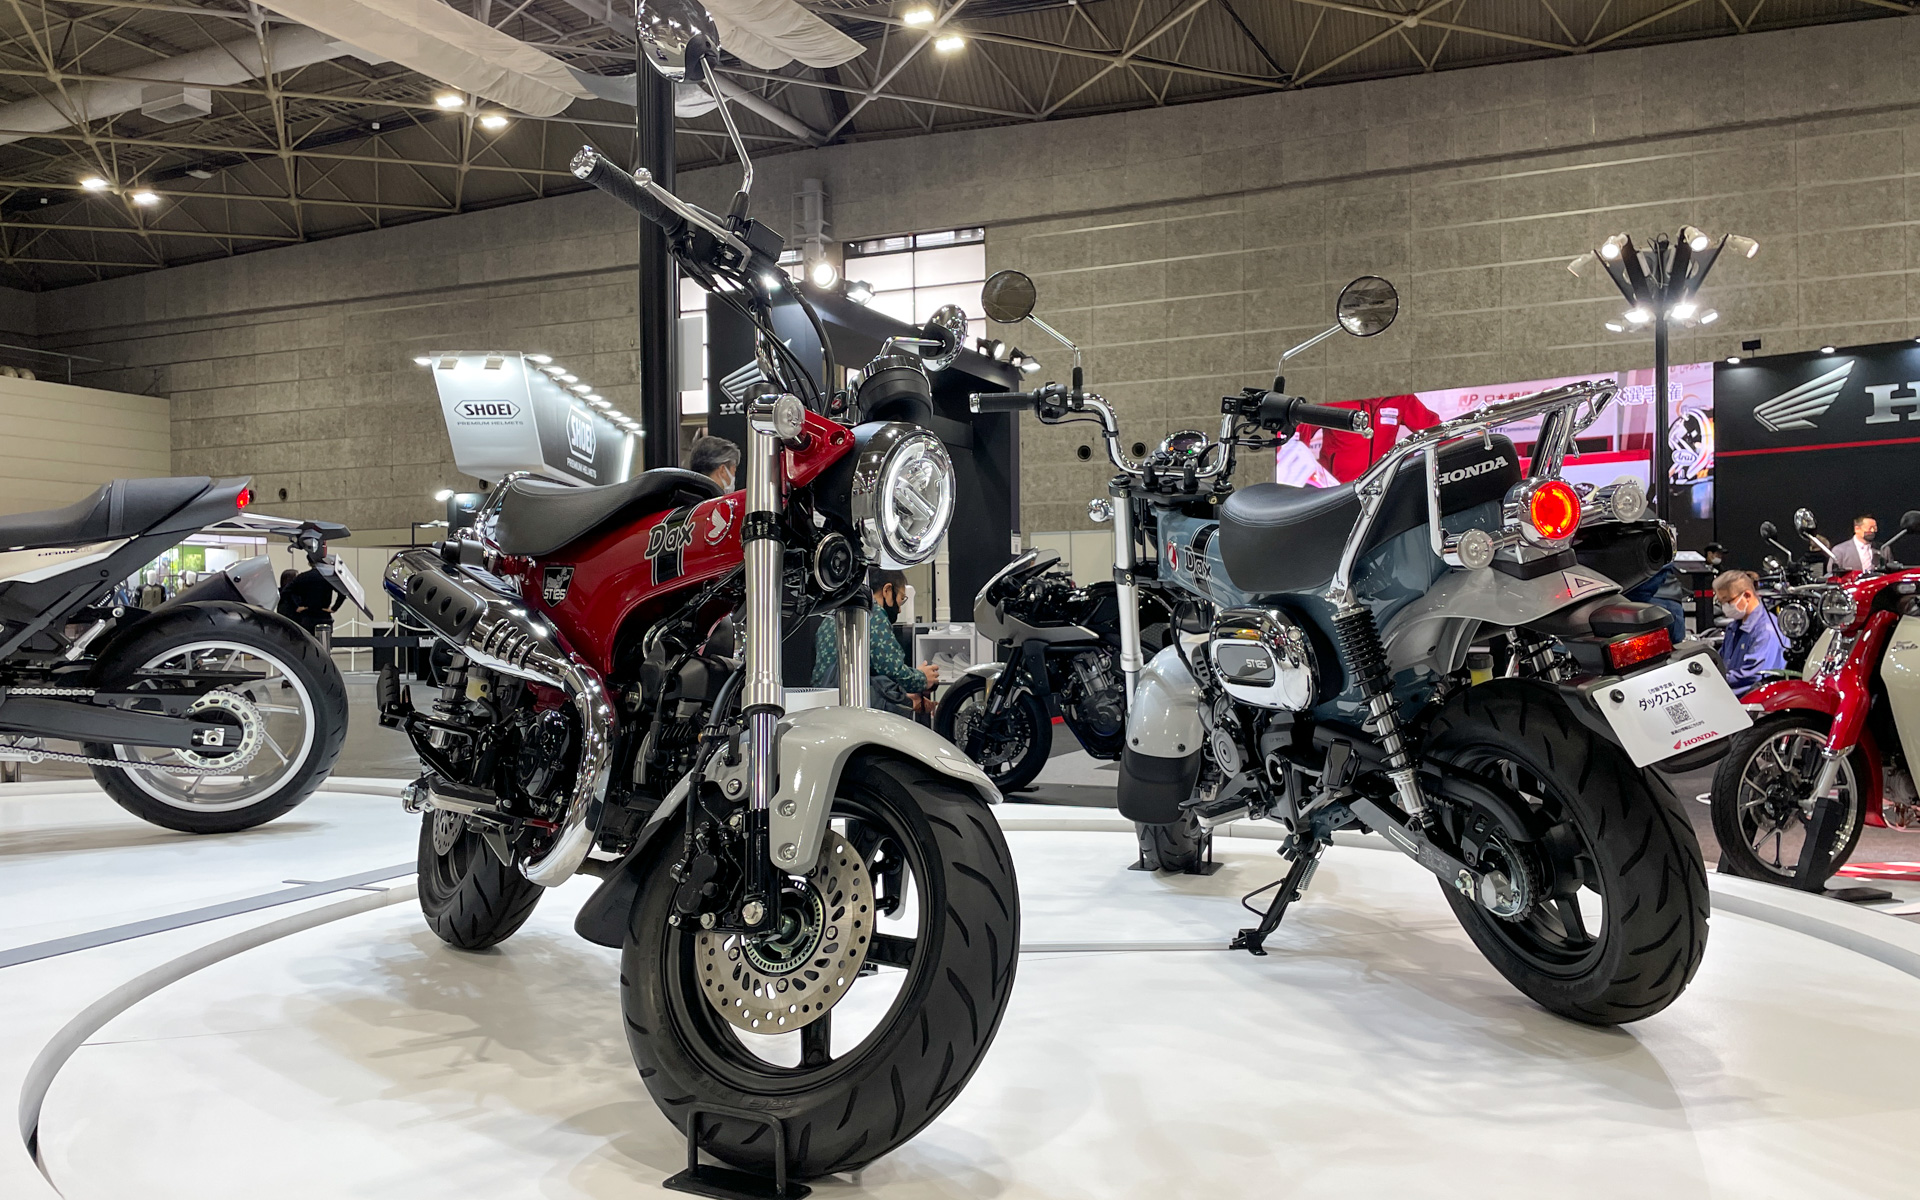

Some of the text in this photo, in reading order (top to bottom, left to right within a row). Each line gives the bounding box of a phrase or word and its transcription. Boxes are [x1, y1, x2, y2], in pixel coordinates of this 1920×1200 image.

[464, 403, 512, 416] SHOEI
[571, 415, 593, 454] SHOEI
[566, 457, 582, 471] PREMIUM
[1438, 456, 1508, 485] HONDA
[644, 521, 696, 559] Dax
[1184, 545, 1213, 582] Dax
[544, 588, 566, 600] ST125
[1246, 659, 1267, 669] ST125
[1639, 682, 1696, 711] ダックス125
[1683, 730, 1719, 747] HONDA
